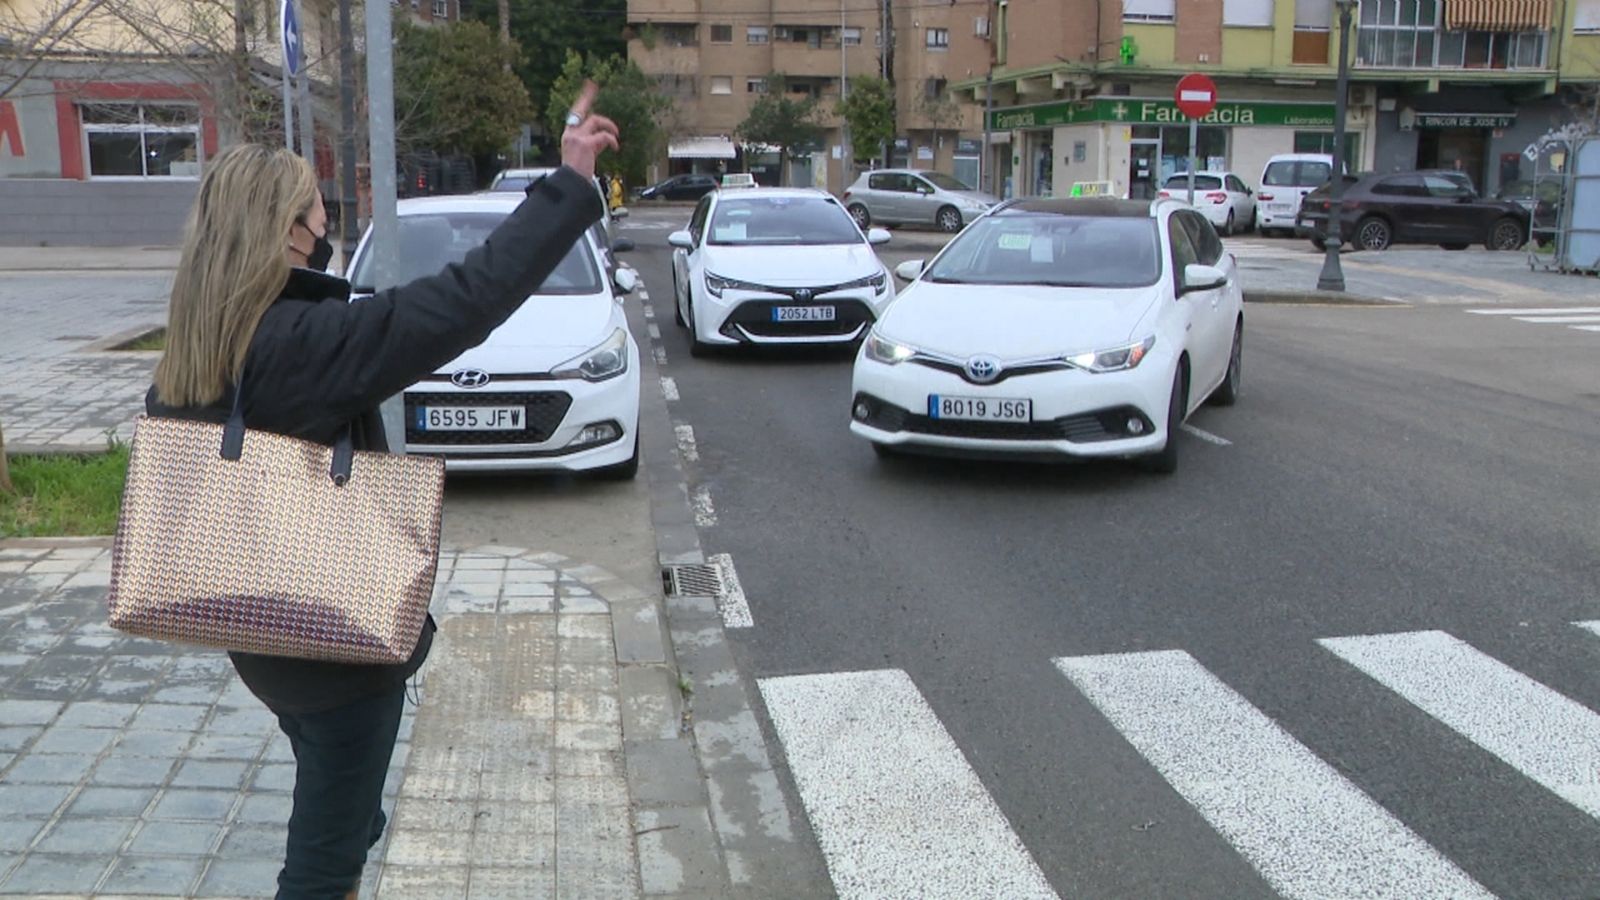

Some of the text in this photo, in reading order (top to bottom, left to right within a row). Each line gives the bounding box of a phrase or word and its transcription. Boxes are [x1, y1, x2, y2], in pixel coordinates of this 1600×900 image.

[1460, 117, 1471, 126] DE
[780, 307, 833, 320] 2052 LTB
[943, 399, 1026, 418] 8019 JSG
[430, 409, 520, 427] 6595 JFW
